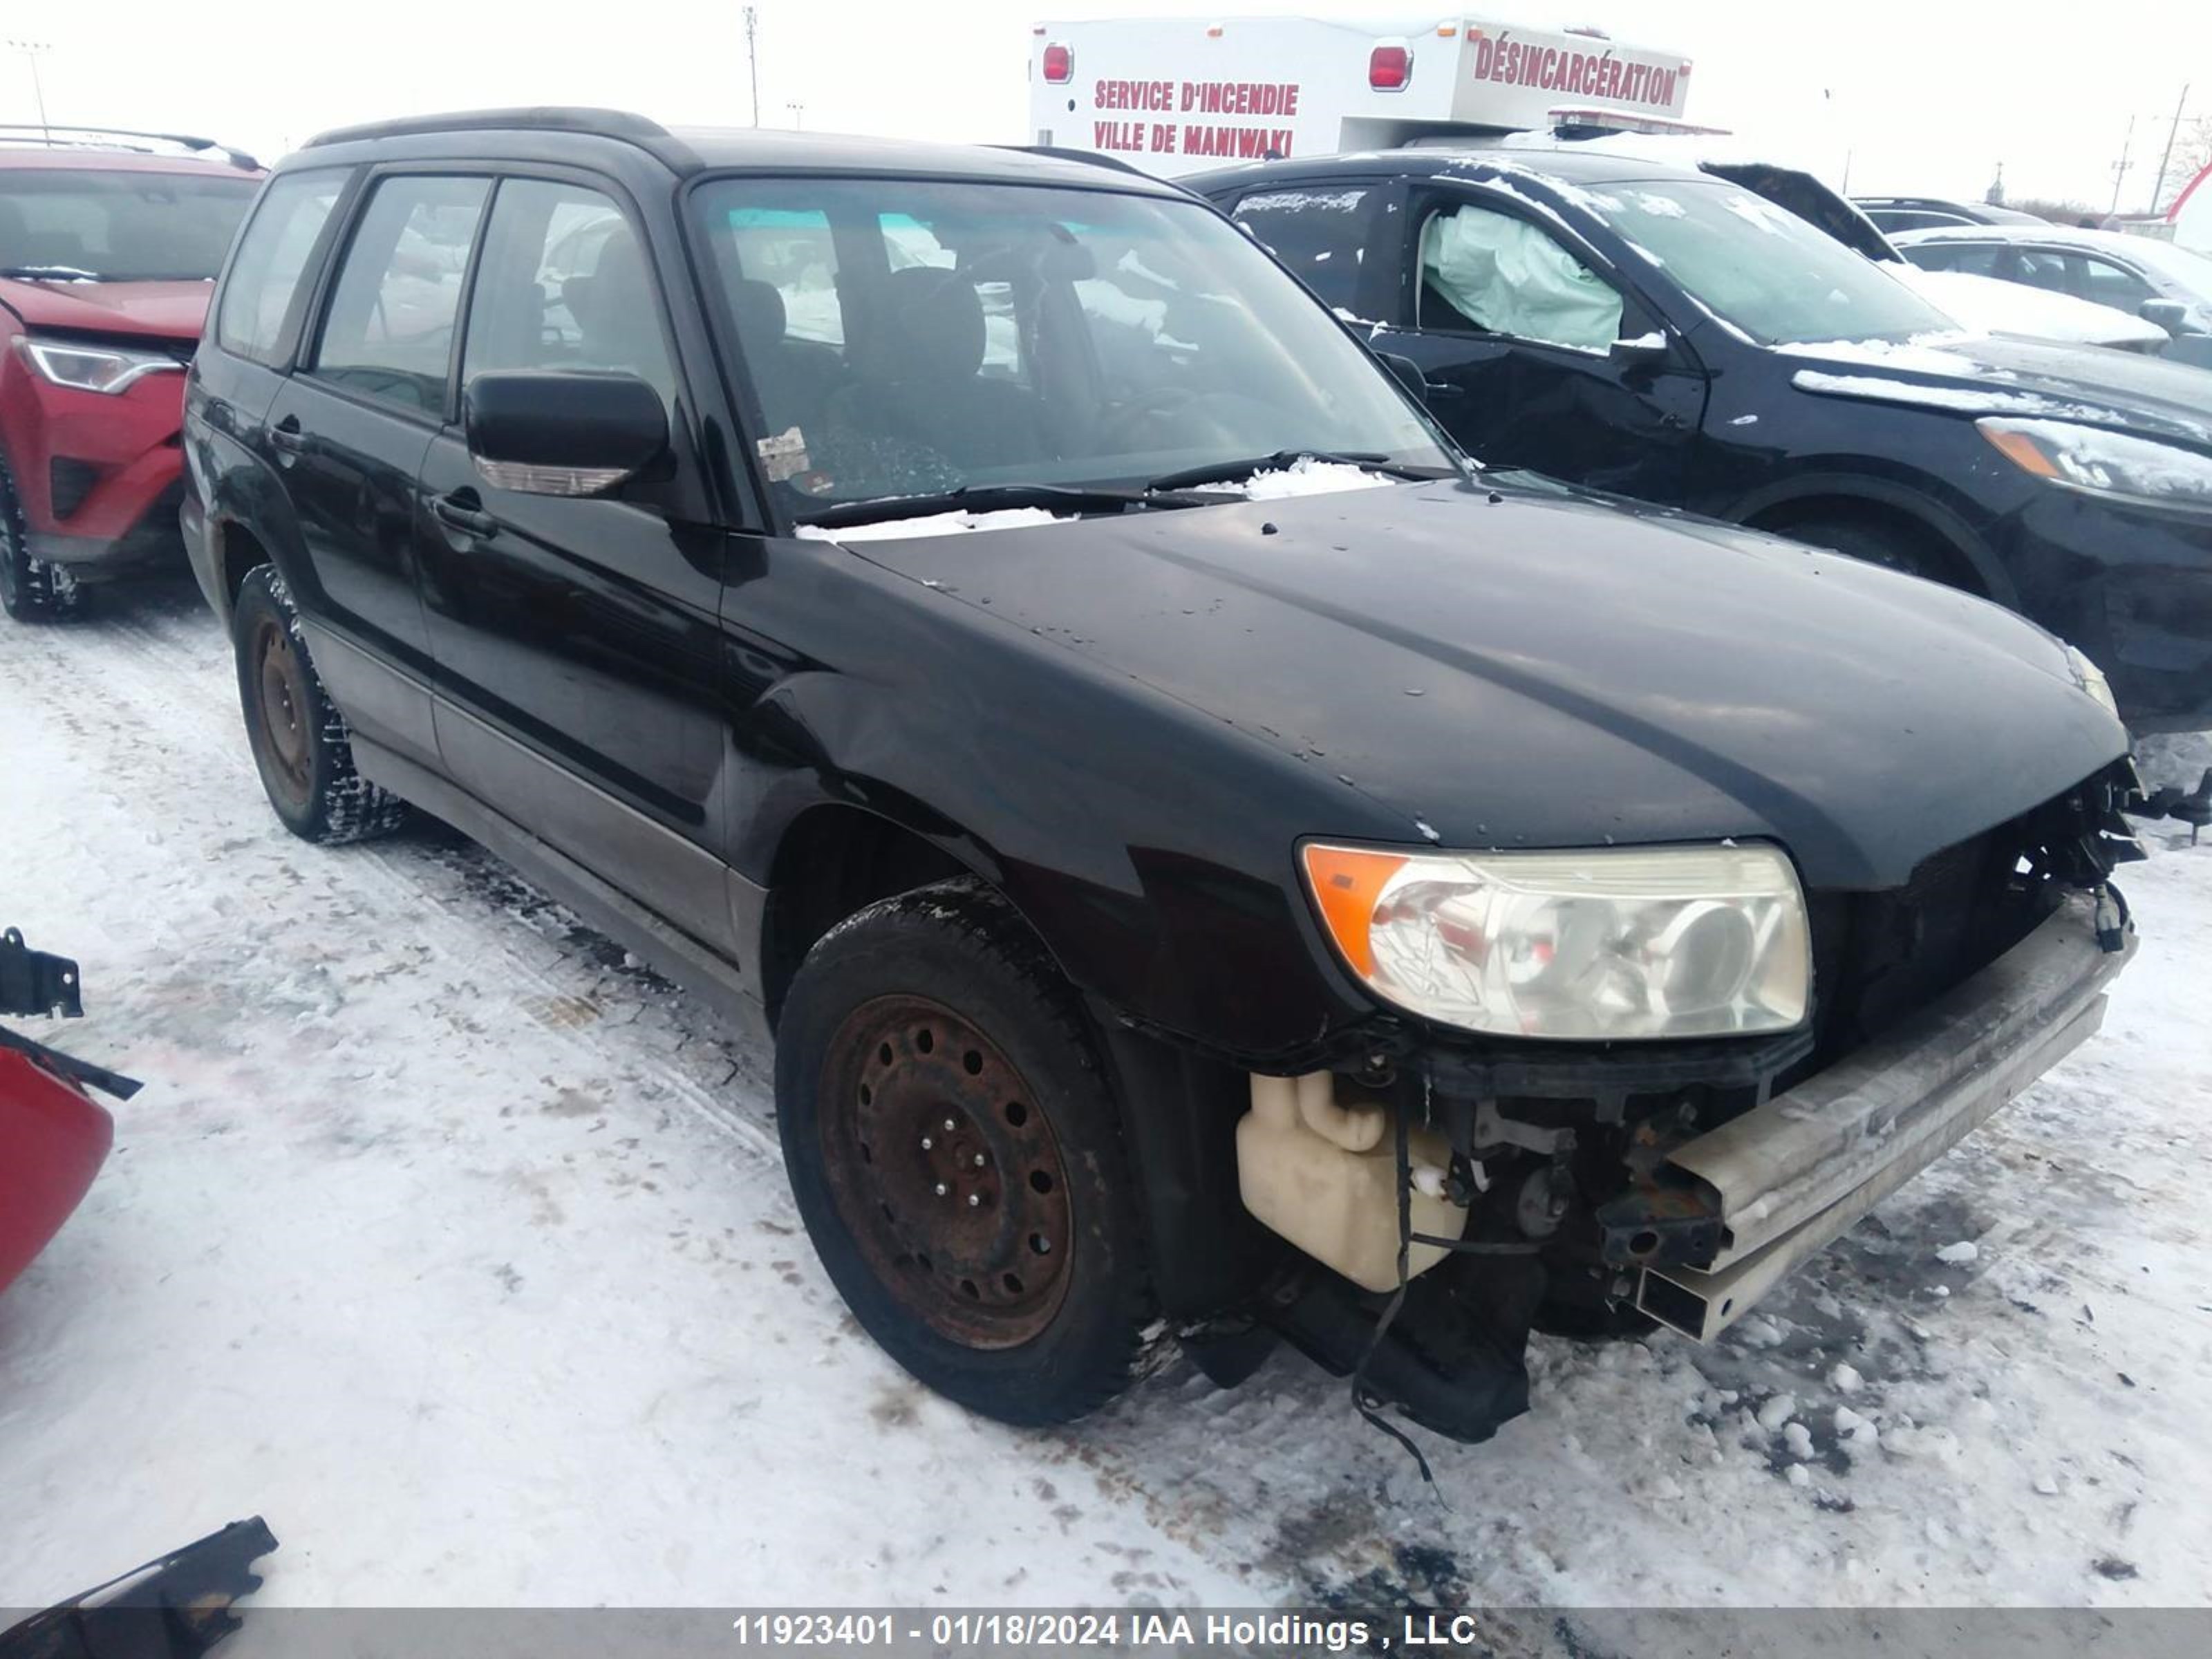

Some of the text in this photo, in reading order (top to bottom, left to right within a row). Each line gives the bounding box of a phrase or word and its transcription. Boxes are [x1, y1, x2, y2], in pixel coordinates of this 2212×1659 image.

[1474, 31, 1677, 106] DÉSINCARCÉRATION
[1094, 79, 1300, 116] SERVICE D'INCENDIE
[1094, 121, 1293, 159] VILLE DE MANIWAKI
